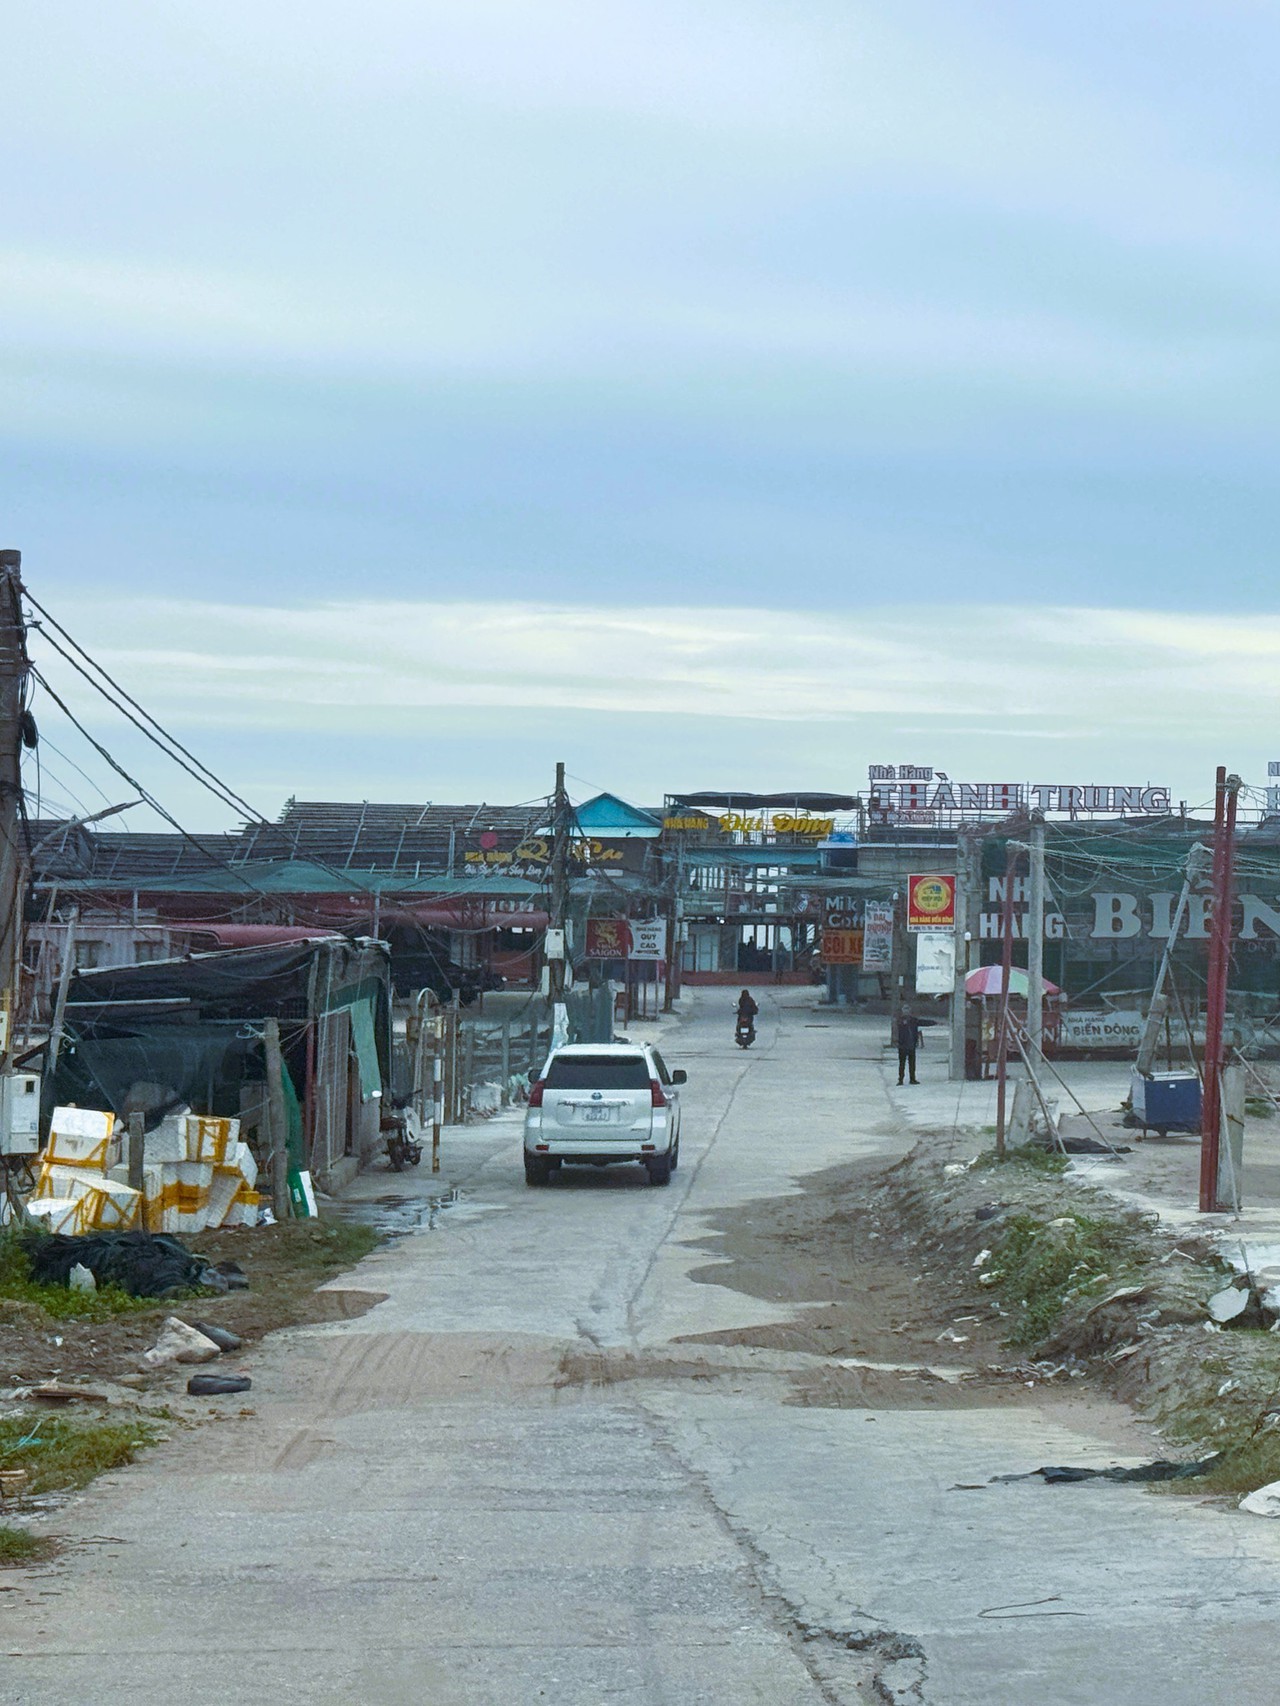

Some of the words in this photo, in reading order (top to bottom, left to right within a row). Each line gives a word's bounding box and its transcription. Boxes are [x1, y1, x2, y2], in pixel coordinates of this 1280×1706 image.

[869, 765, 896, 781] Nhà
[899, 764, 934, 782] Hàng
[871, 772, 1021, 810] THÀNH
[1032, 784, 1171, 814] TRUNG
[589, 948, 623, 957] SAIGON
[1103, 1021, 1141, 1035] ĐÔNG
